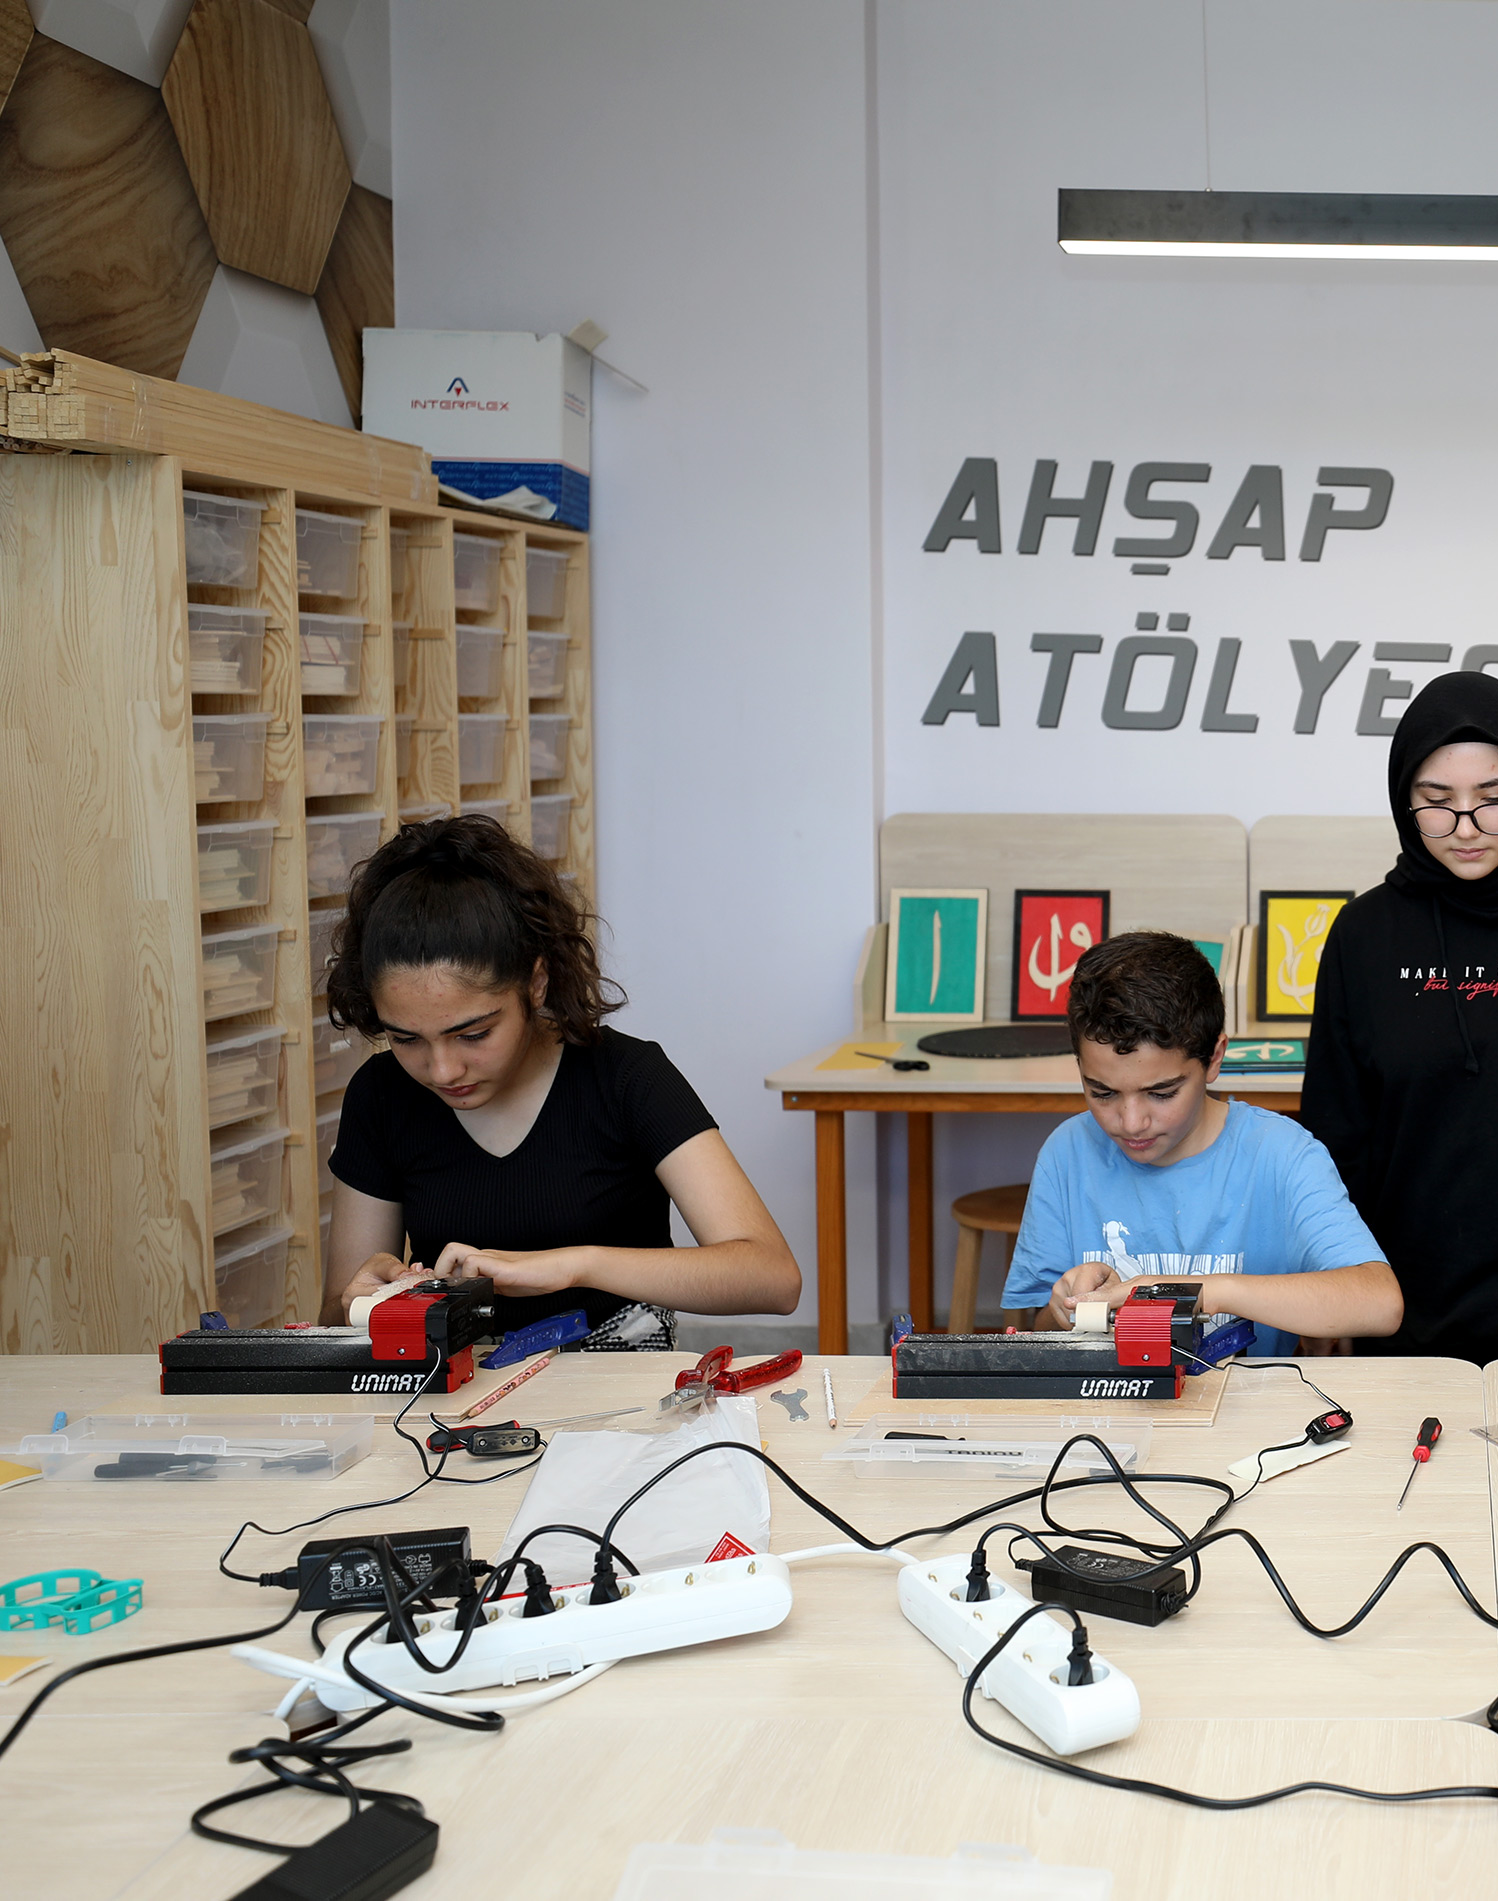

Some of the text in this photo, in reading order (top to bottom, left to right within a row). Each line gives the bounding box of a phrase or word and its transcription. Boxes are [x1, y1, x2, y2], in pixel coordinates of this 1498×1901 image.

[410, 399, 510, 411] INTERFLEX
[920, 456, 1395, 576] AHŞAP
[1465, 966, 1485, 978] IT
[351, 1374, 426, 1392] UNIMAT
[1080, 1379, 1154, 1397] UNIMAT
